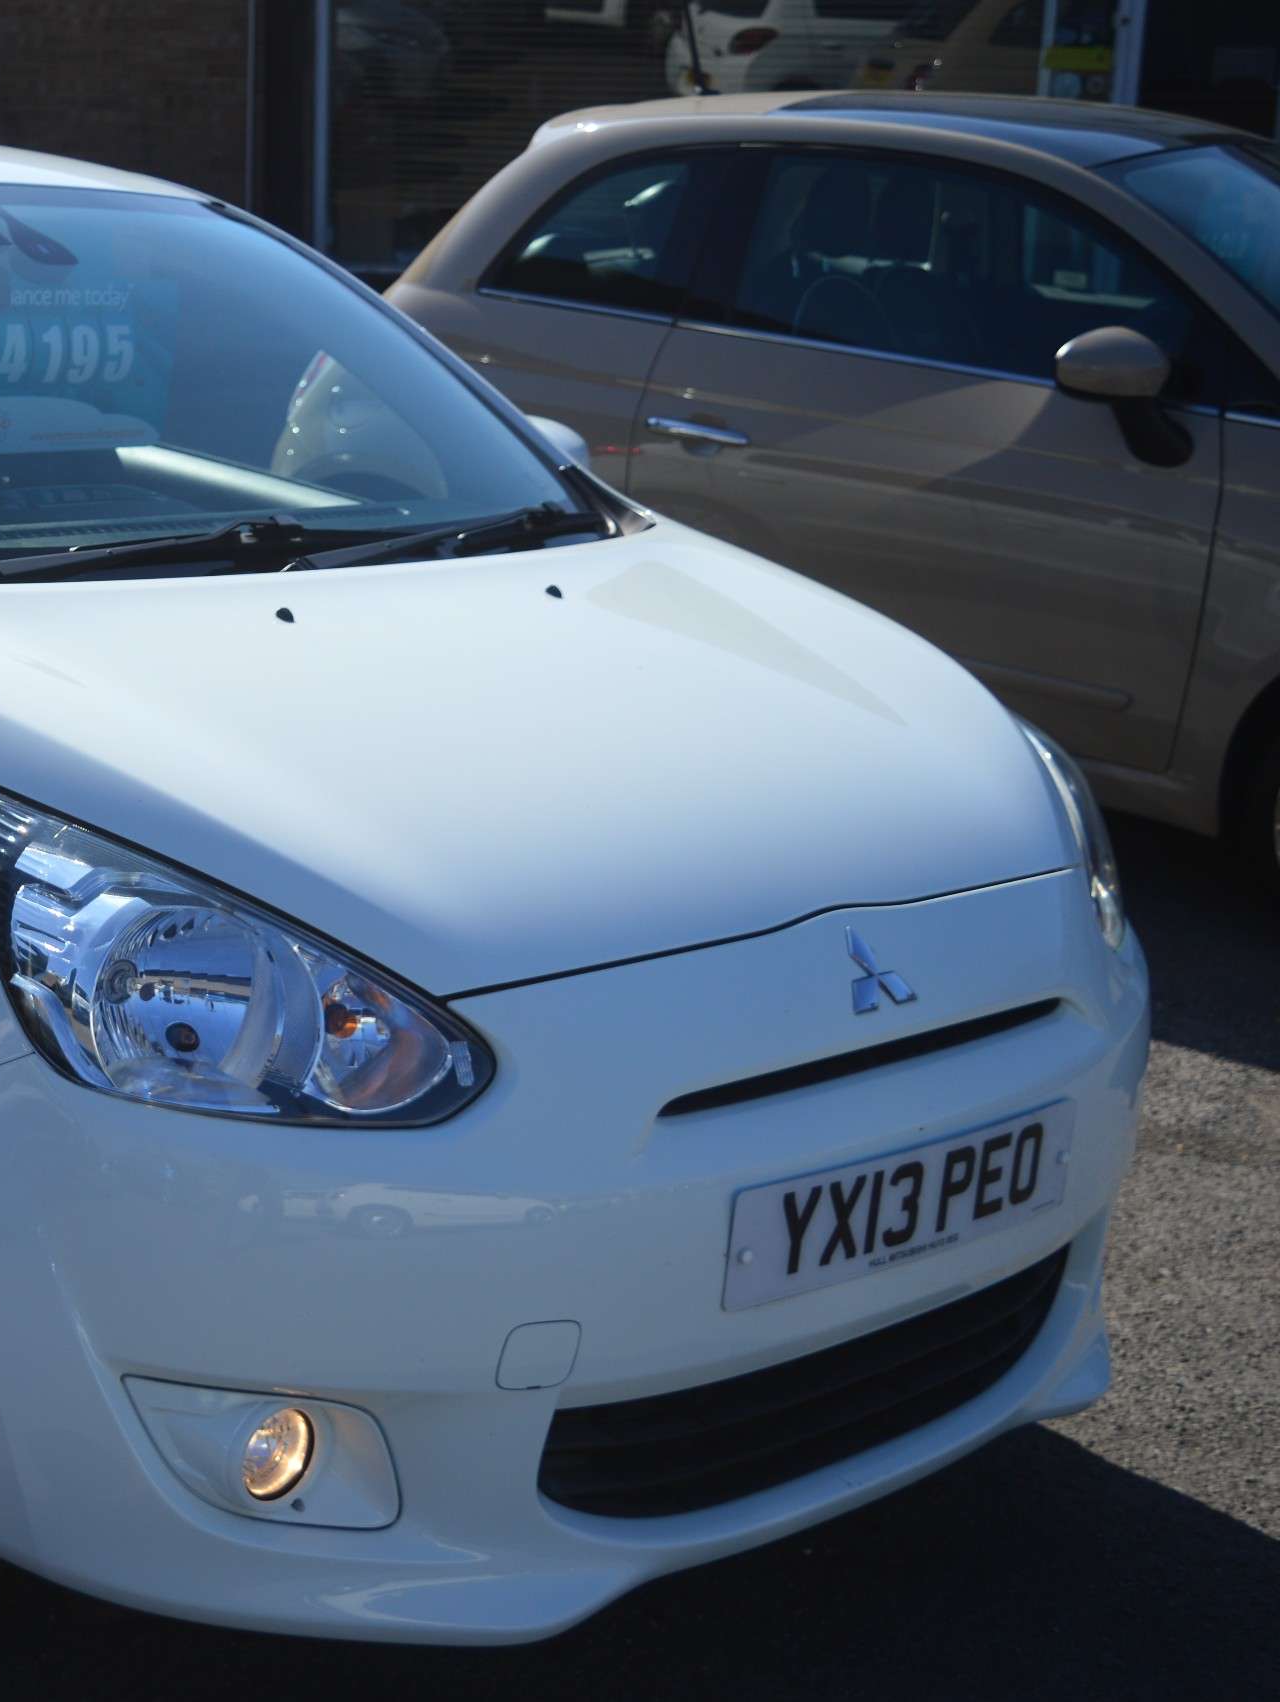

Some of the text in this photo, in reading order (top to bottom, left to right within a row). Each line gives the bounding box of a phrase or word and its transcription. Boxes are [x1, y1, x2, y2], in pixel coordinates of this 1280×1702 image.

[56, 288, 81, 305] me
[781, 1121, 1045, 1276] YX13 PEO
